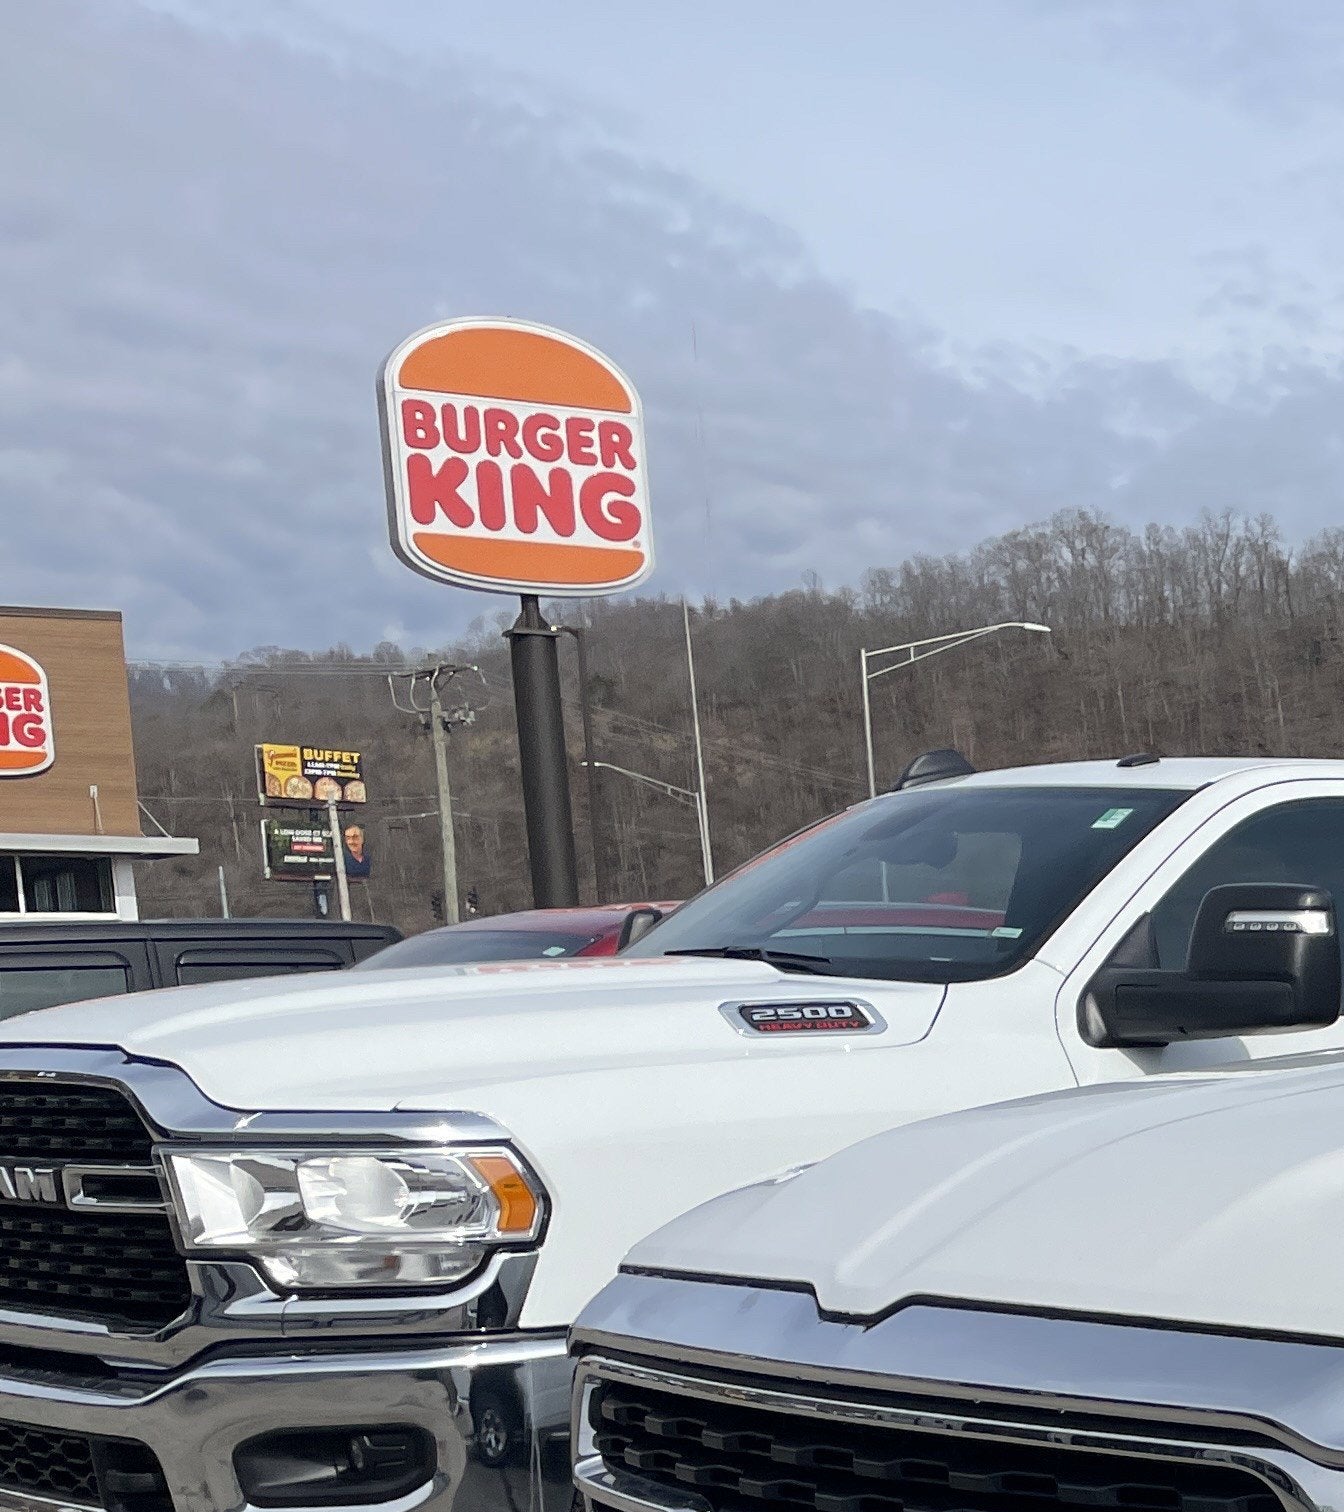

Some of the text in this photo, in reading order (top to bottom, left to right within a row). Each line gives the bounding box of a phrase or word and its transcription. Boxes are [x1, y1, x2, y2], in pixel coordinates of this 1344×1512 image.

[401, 398, 637, 470] BURGER
[406, 452, 642, 542] KING
[303, 748, 360, 764] BUFFET
[751, 1005, 853, 1022] 2500
[758, 1020, 860, 1032] HEAVY DUTY
